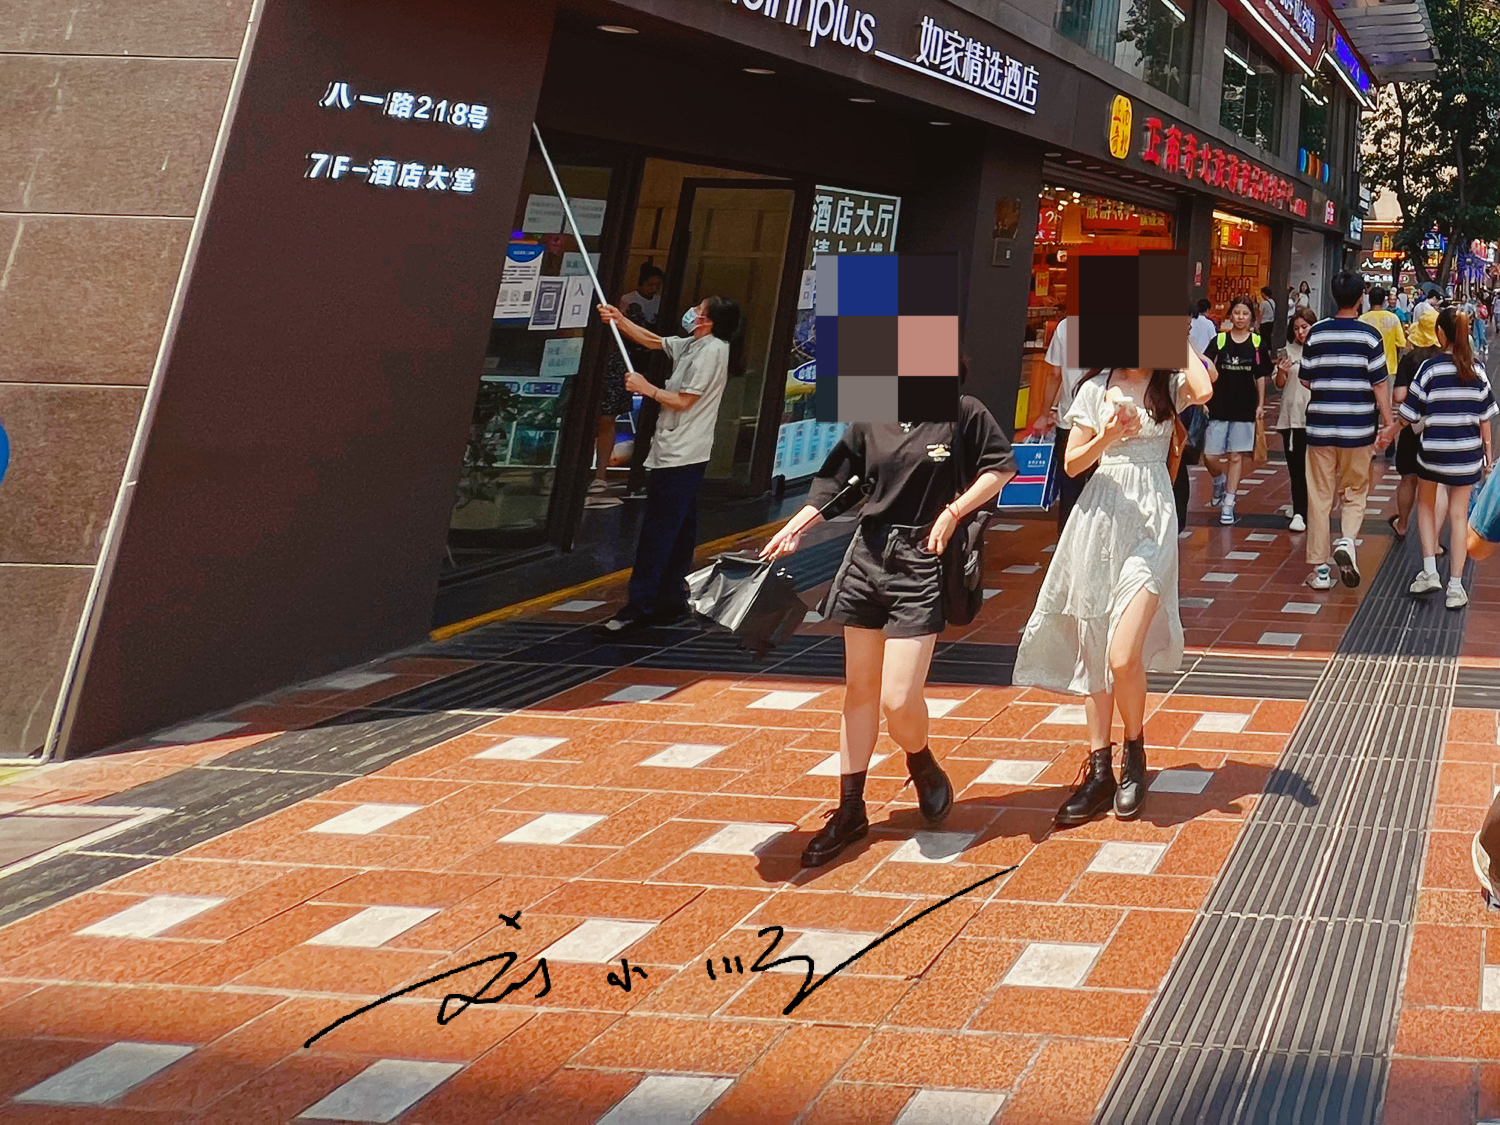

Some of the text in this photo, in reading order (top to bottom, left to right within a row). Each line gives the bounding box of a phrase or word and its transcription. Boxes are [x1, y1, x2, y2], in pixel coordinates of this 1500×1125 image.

[915, 15, 1041, 107] 如家精选酒店
[321, 81, 489, 130] 八一路218号
[809, 194, 895, 238] 酒店大厅
